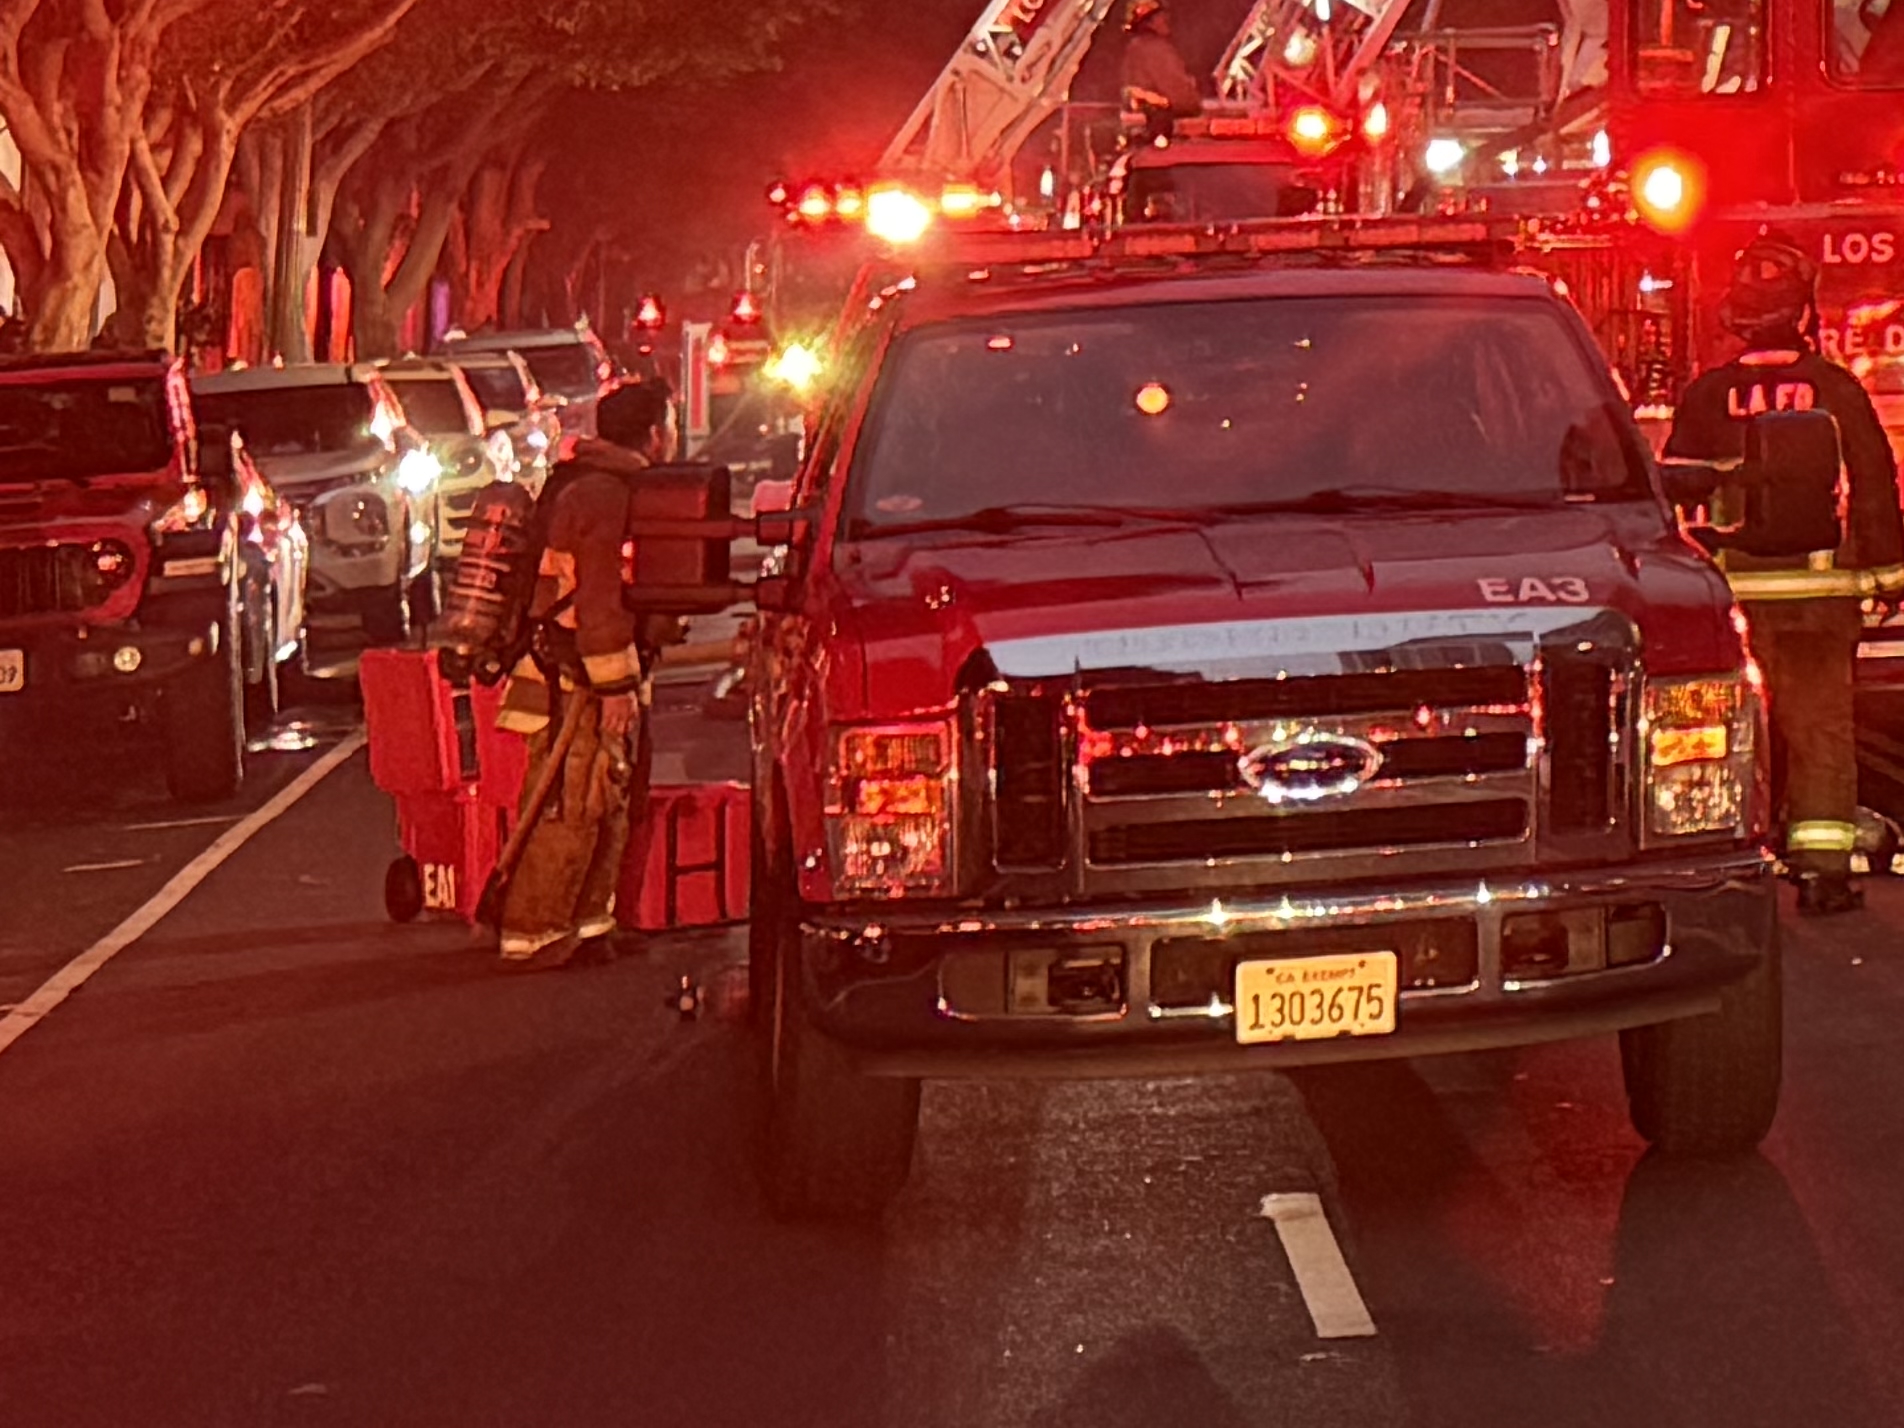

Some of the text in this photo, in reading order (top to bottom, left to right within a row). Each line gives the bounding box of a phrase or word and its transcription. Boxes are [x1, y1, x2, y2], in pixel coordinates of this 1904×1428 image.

[1822, 232, 1895, 264] LOS
[1727, 381, 1815, 417] LAFD
[1477, 575, 1591, 603] EA3
[1248, 982, 1385, 1032] 1303675
